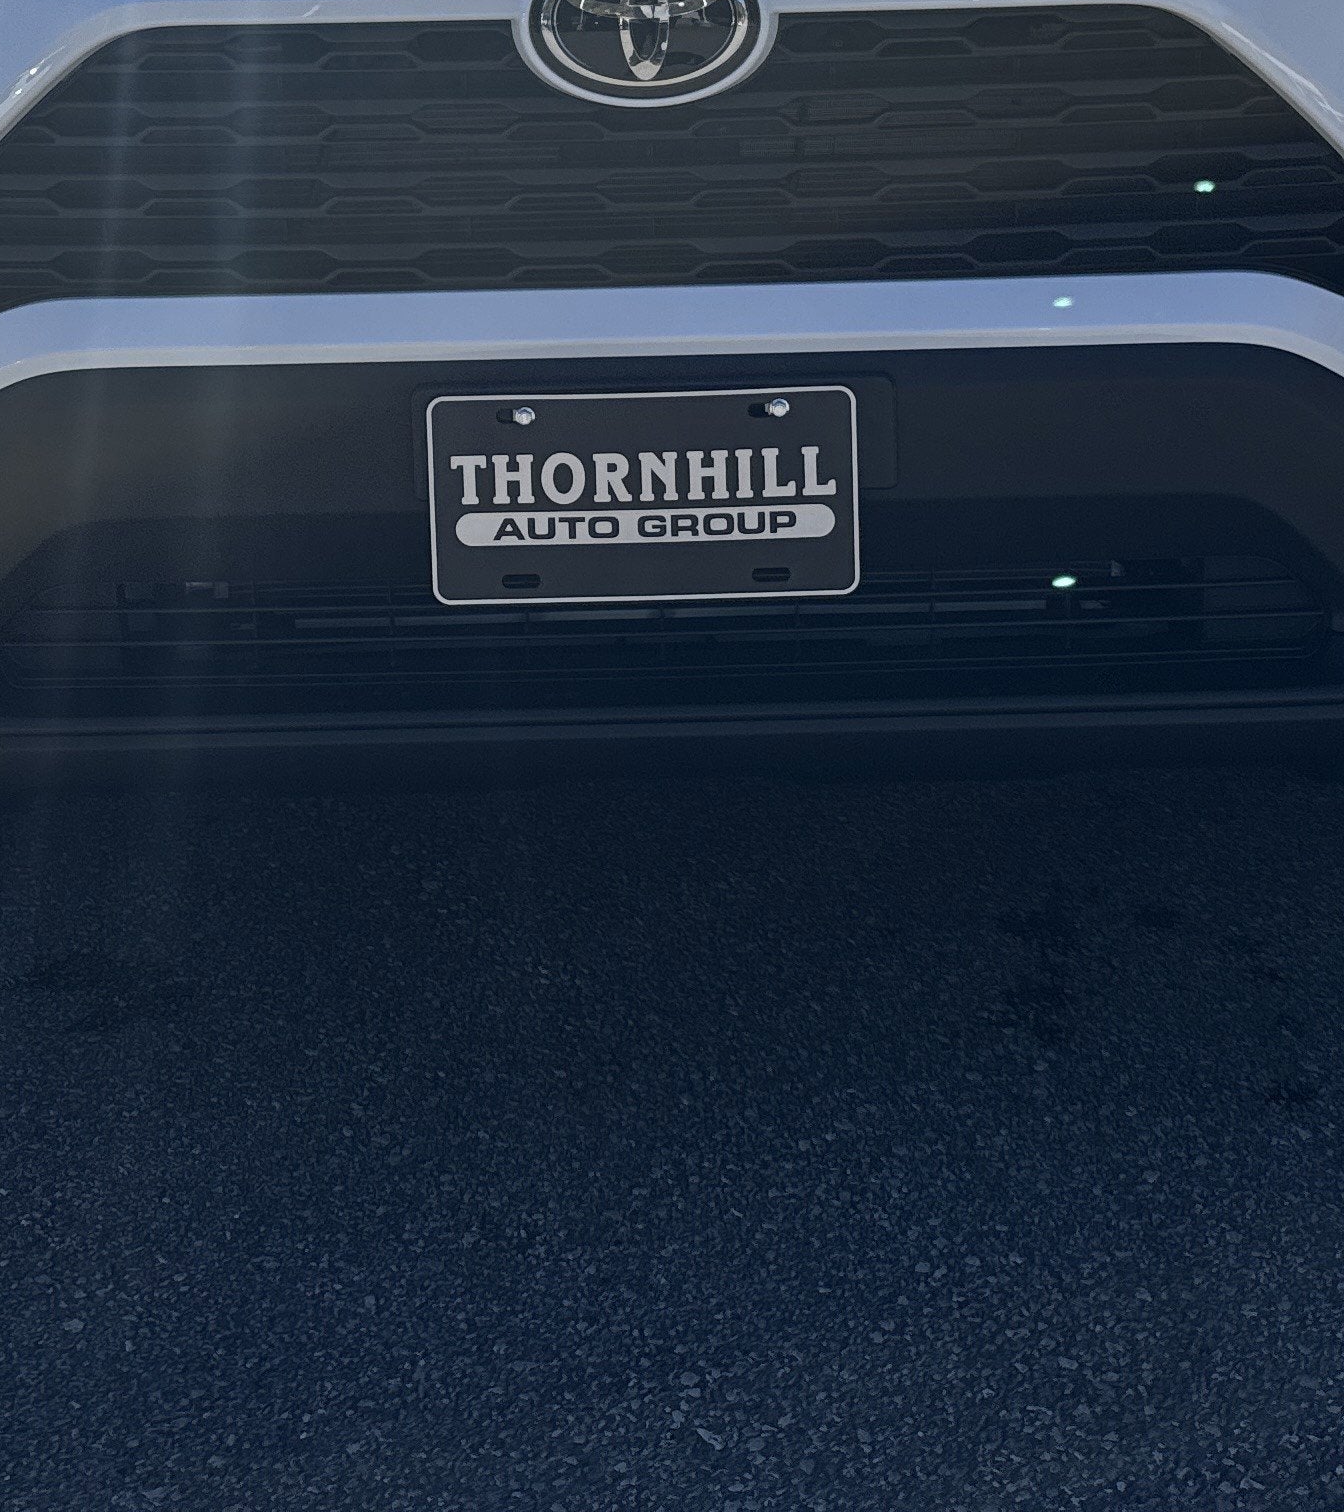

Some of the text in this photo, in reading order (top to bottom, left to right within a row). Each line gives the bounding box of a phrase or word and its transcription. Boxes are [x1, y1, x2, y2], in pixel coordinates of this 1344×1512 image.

[450, 446, 837, 505] THORNHILL
[493, 511, 798, 541] AUTO GROUP
